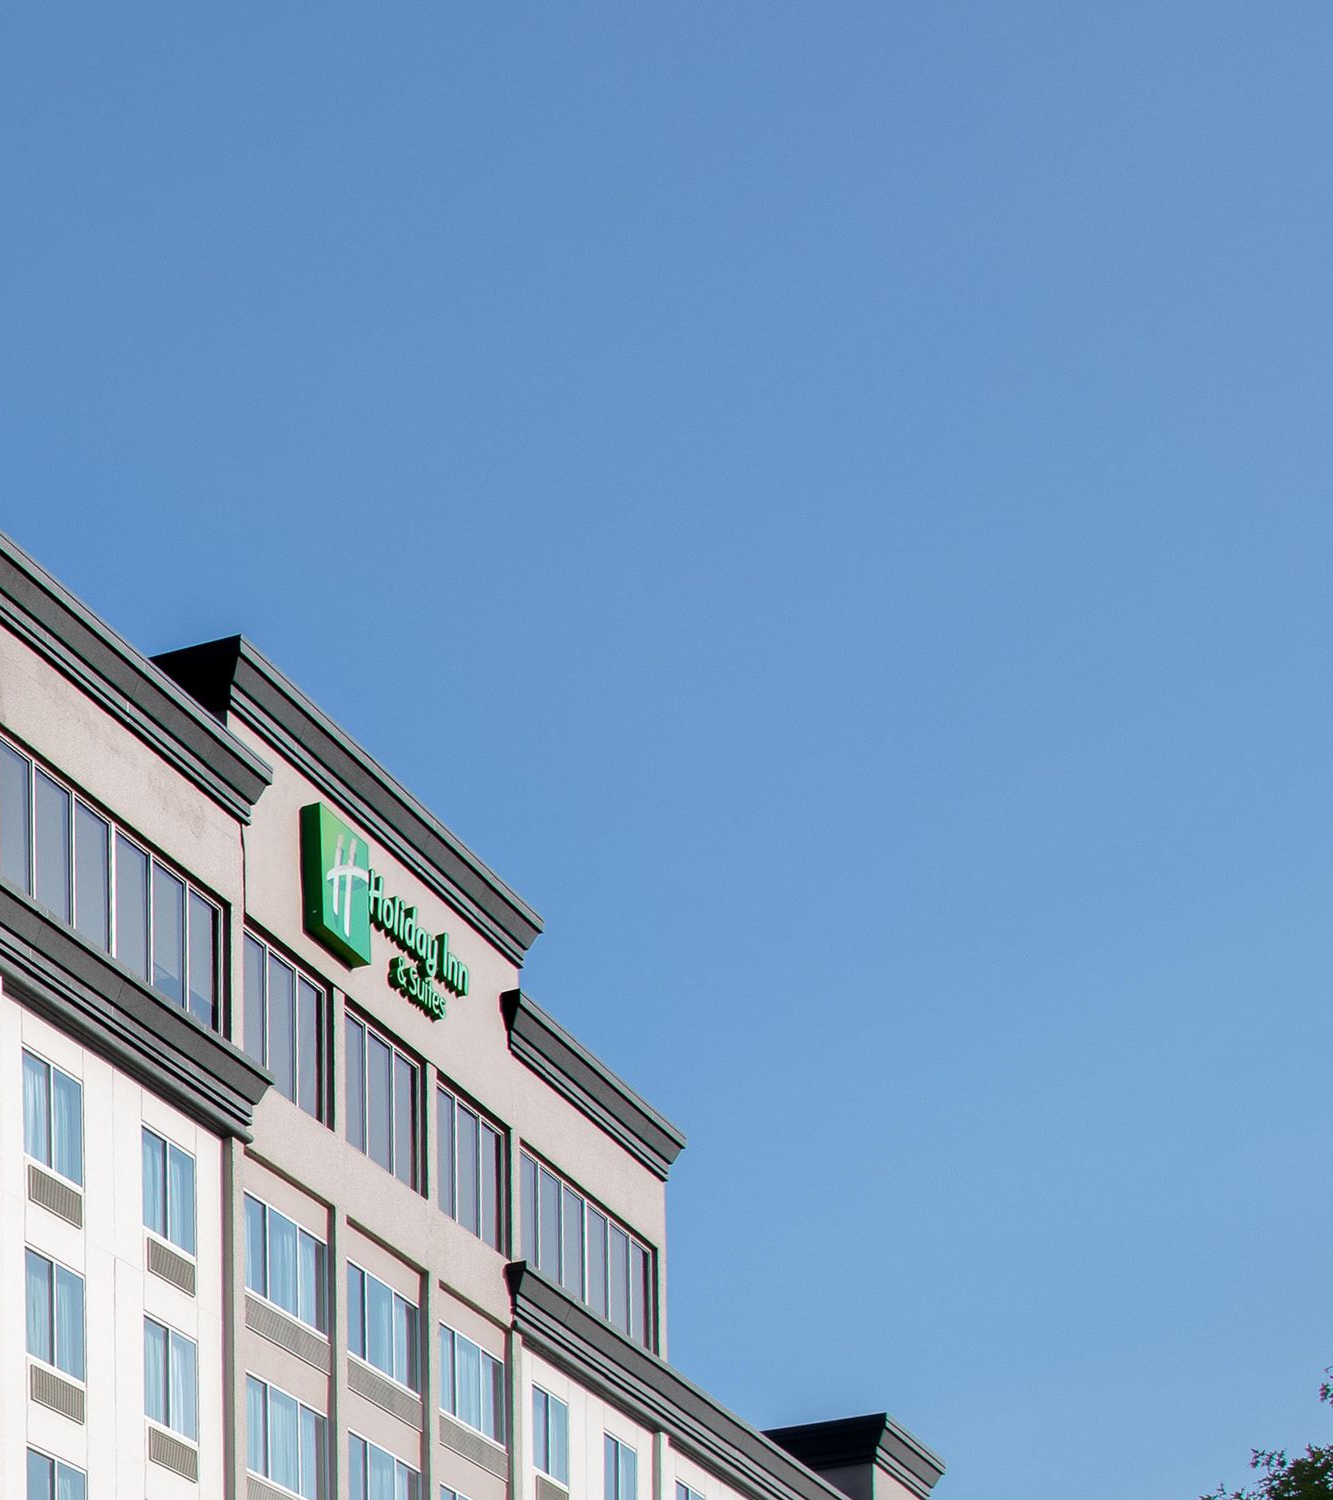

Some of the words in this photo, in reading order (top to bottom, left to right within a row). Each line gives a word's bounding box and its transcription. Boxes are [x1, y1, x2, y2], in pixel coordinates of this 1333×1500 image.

[368, 868, 439, 979] Holiday
[440, 932, 469, 998] Inn
[392, 956, 407, 991] &
[406, 966, 447, 1022] Suites
